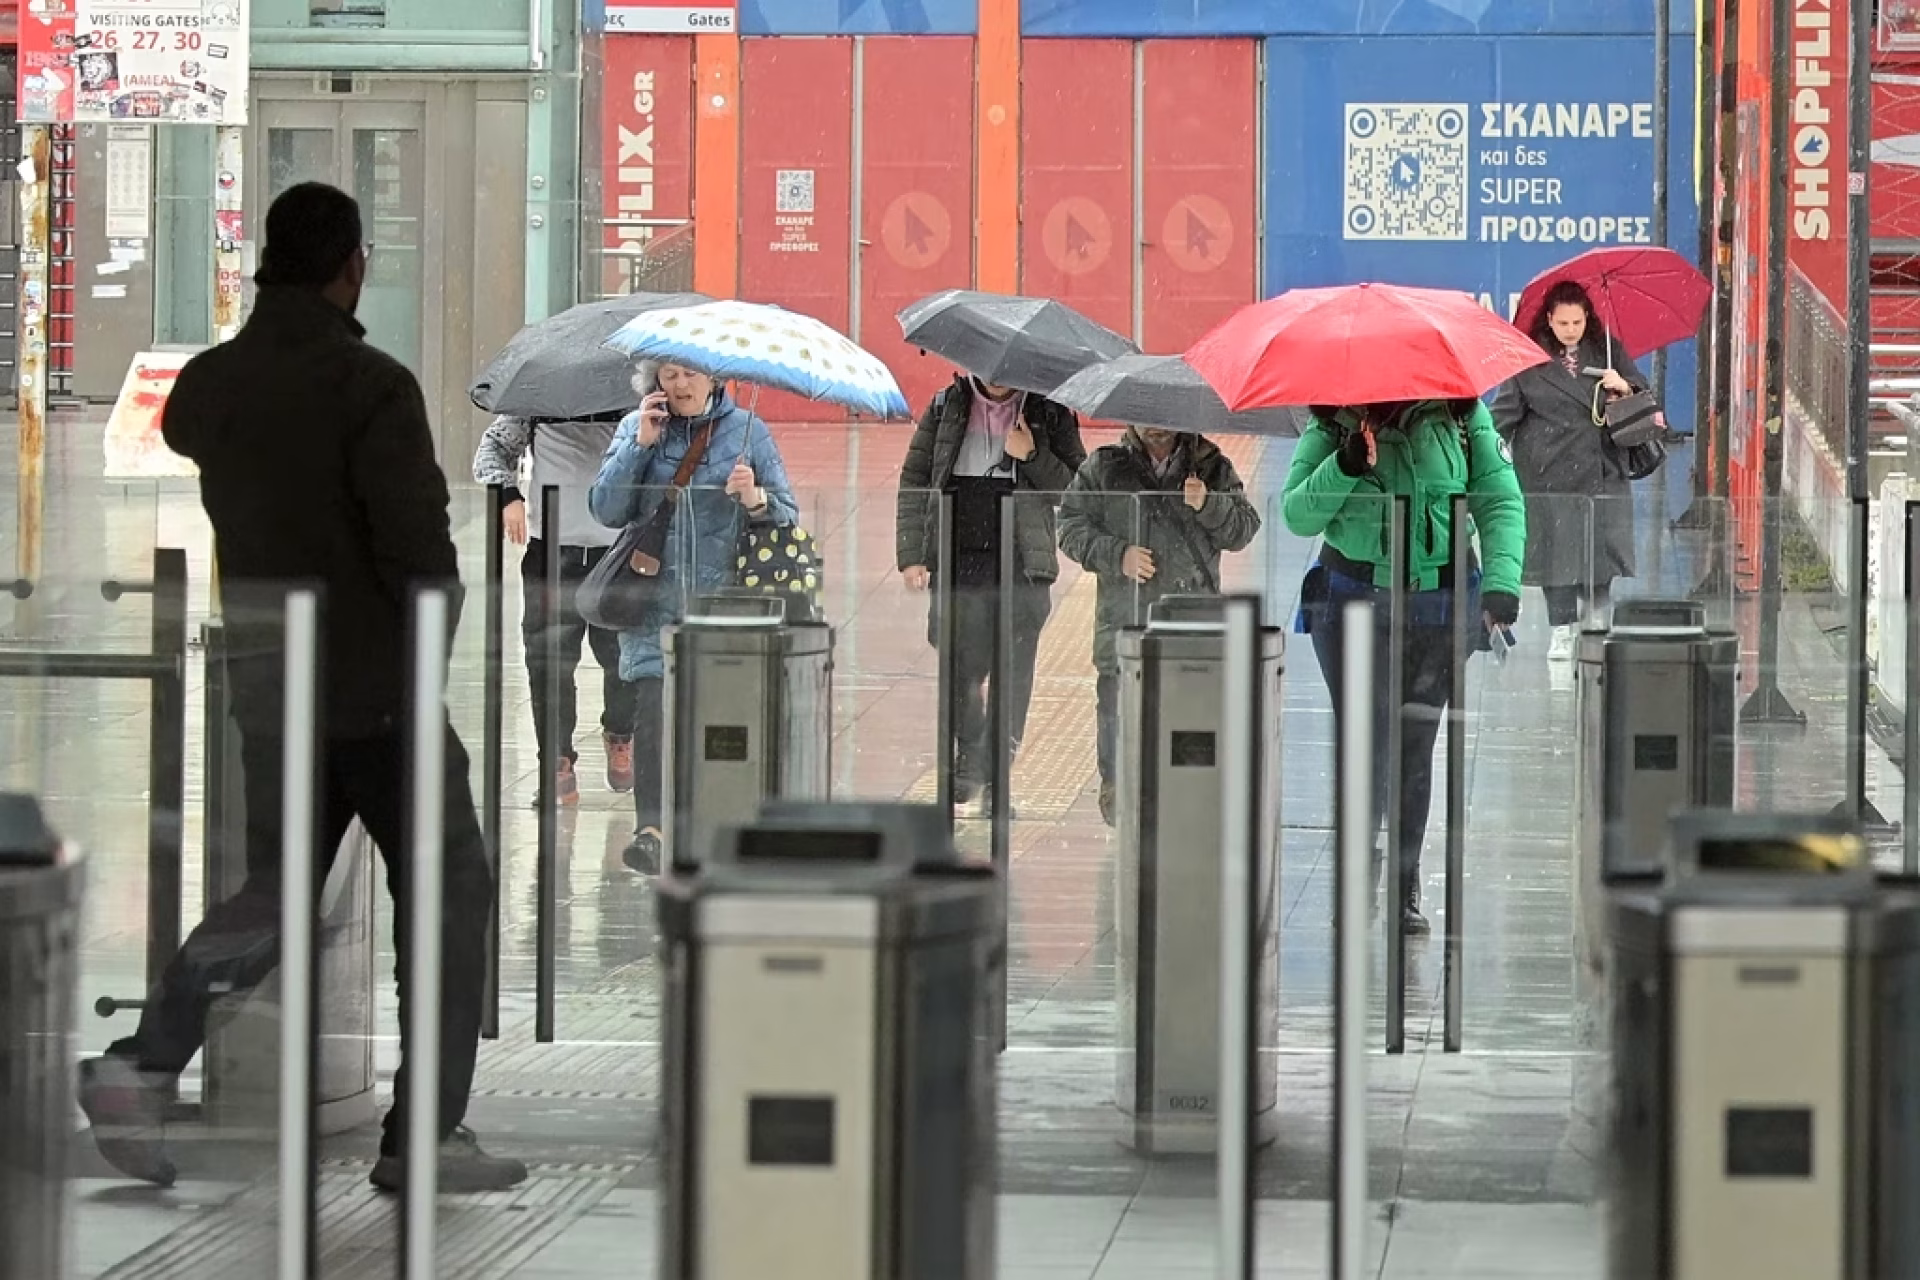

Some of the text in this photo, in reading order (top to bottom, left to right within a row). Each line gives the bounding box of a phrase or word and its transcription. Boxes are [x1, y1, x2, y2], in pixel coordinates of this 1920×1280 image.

[90, 14, 151, 27] VISITING
[155, 14, 200, 27] GATES
[687, 12, 730, 27] Gates
[132, 31, 166, 53] 27,
[174, 31, 202, 50] 30
[1480, 103, 1653, 138] ΣΚΑΝΑΡΕ
[1794, 0, 1831, 240] SHOPFLI
[1480, 150, 1508, 166] και
[1480, 177, 1562, 204] SUPER
[1480, 216, 1651, 243] ΠΡΟΣΦΟΡΕΣ
